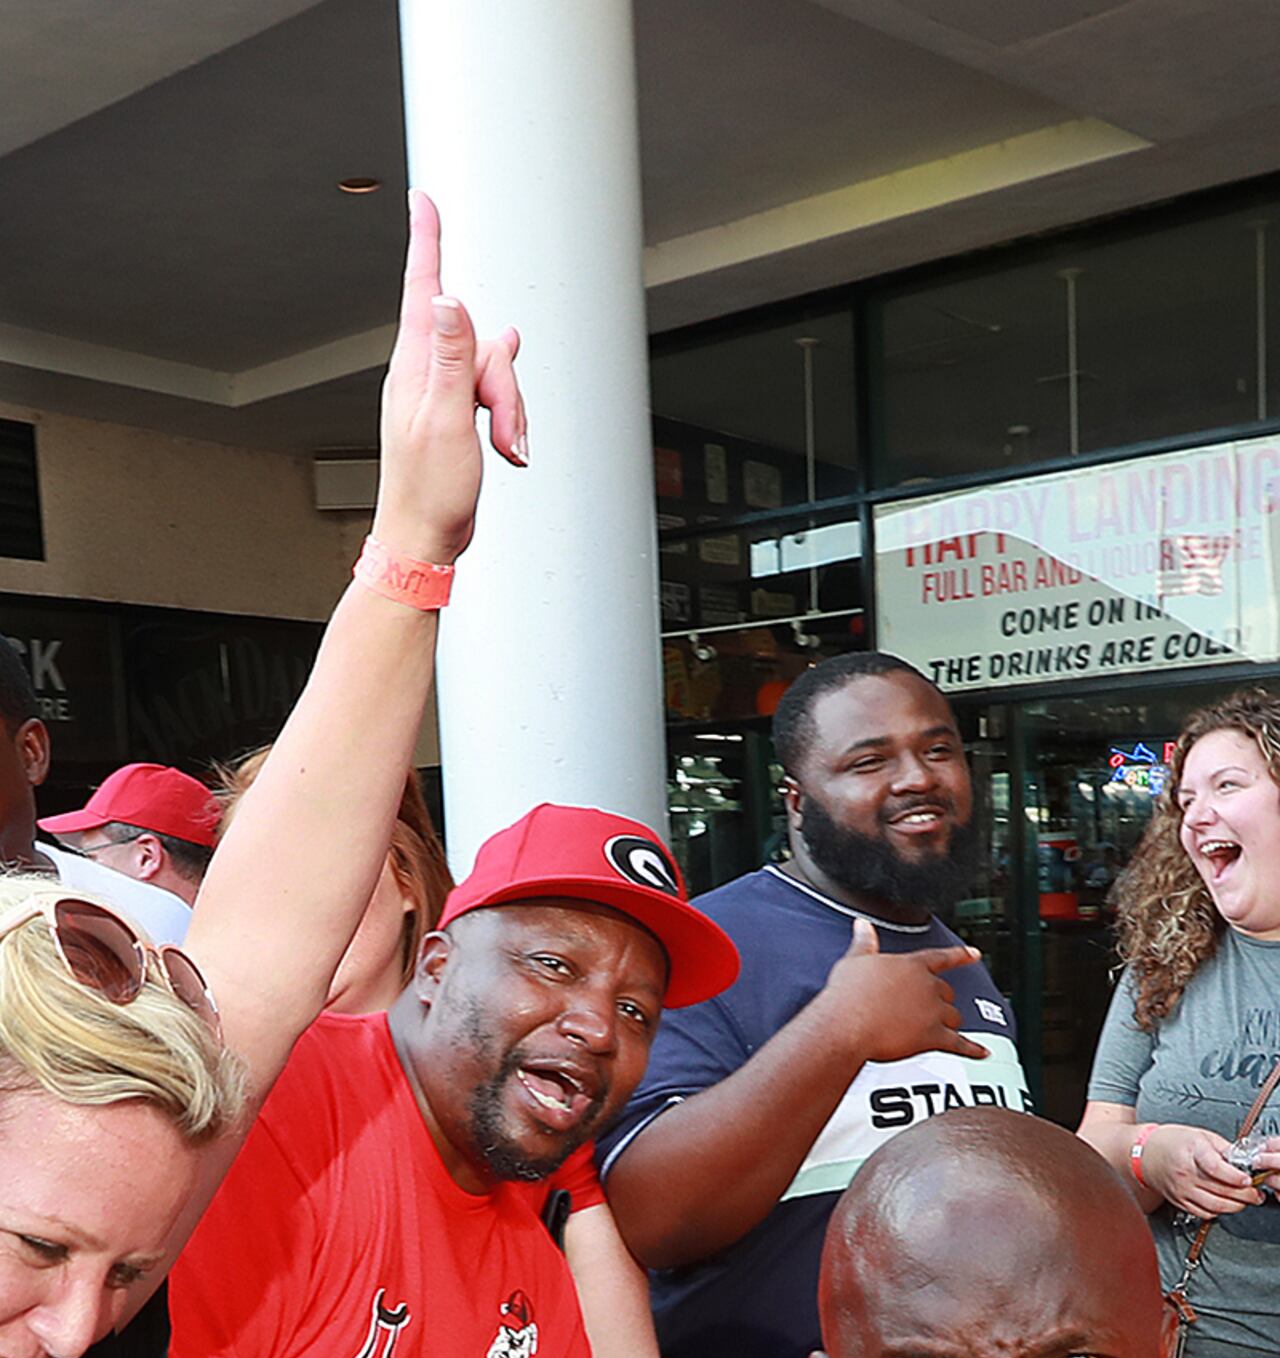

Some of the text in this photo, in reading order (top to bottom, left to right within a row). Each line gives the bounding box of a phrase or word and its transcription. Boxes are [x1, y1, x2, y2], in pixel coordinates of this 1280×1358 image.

[904, 485, 1050, 568] HAPPY
[922, 567, 975, 604] FULL
[982, 560, 1028, 596] BAR
[1035, 549, 1084, 589] AND
[1001, 601, 1079, 637] COME
[1087, 597, 1125, 627] ON
[929, 655, 981, 685] THE
[989, 644, 1091, 679] DRINKS
[1099, 636, 1156, 668] ARE
